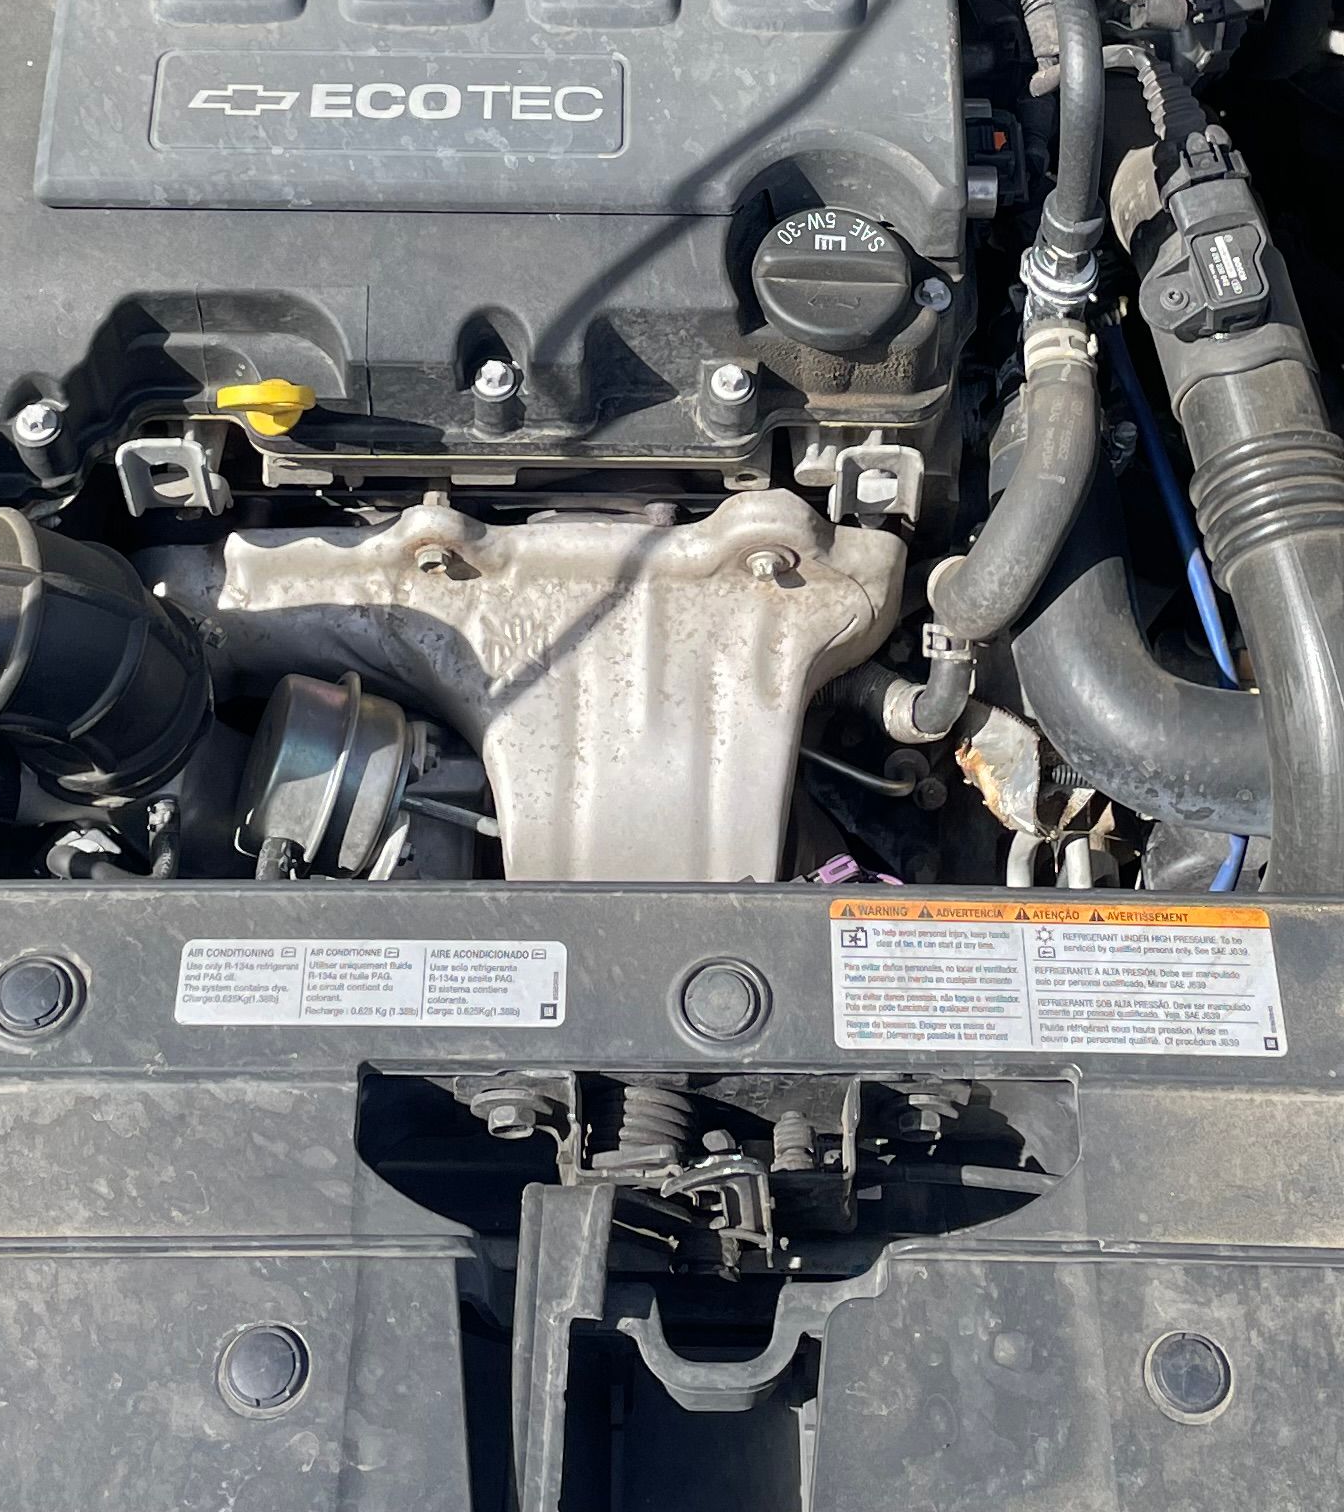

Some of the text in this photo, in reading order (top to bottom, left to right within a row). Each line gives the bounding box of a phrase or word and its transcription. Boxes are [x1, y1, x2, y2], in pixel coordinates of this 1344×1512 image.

[310, 83, 605, 122] ECOTEC
[777, 211, 885, 253] SAE 5W-30
[857, 905, 1188, 922] WARNING ADVERTENCIA ATENÇÃO AVERTISSEMENT
[1063, 933, 1118, 942] REFRIGERANT
[1121, 934, 1149, 943] UNDER
[187, 948, 274, 957] AIR CONDITIONING
[310, 948, 324, 957] AIR
[430, 950, 529, 959] AIRE ACONDICIONADO
[1097, 945, 1107, 954] by
[1195, 947, 1209, 955] See
[186, 962, 203, 970] Use
[205, 962, 222, 971] only
[225, 962, 255, 970] R-134a
[339, 972, 347, 980] et
[1035, 967, 1094, 976] REFRIGERANTE
[1094, 968, 1100, 976] A
[1102, 968, 1120, 976] ALTA
[185, 973, 201, 981] and
[203, 973, 222, 981] PAG
[201, 984, 232, 993] system
[307, 983, 318, 991] Le
[428, 985, 436, 993] El
[438, 985, 470, 993] sistema
[1096, 1000, 1112, 1008] SOB
[305, 1007, 344, 1016] Recharge
[376, 1007, 387, 1016] Kg
